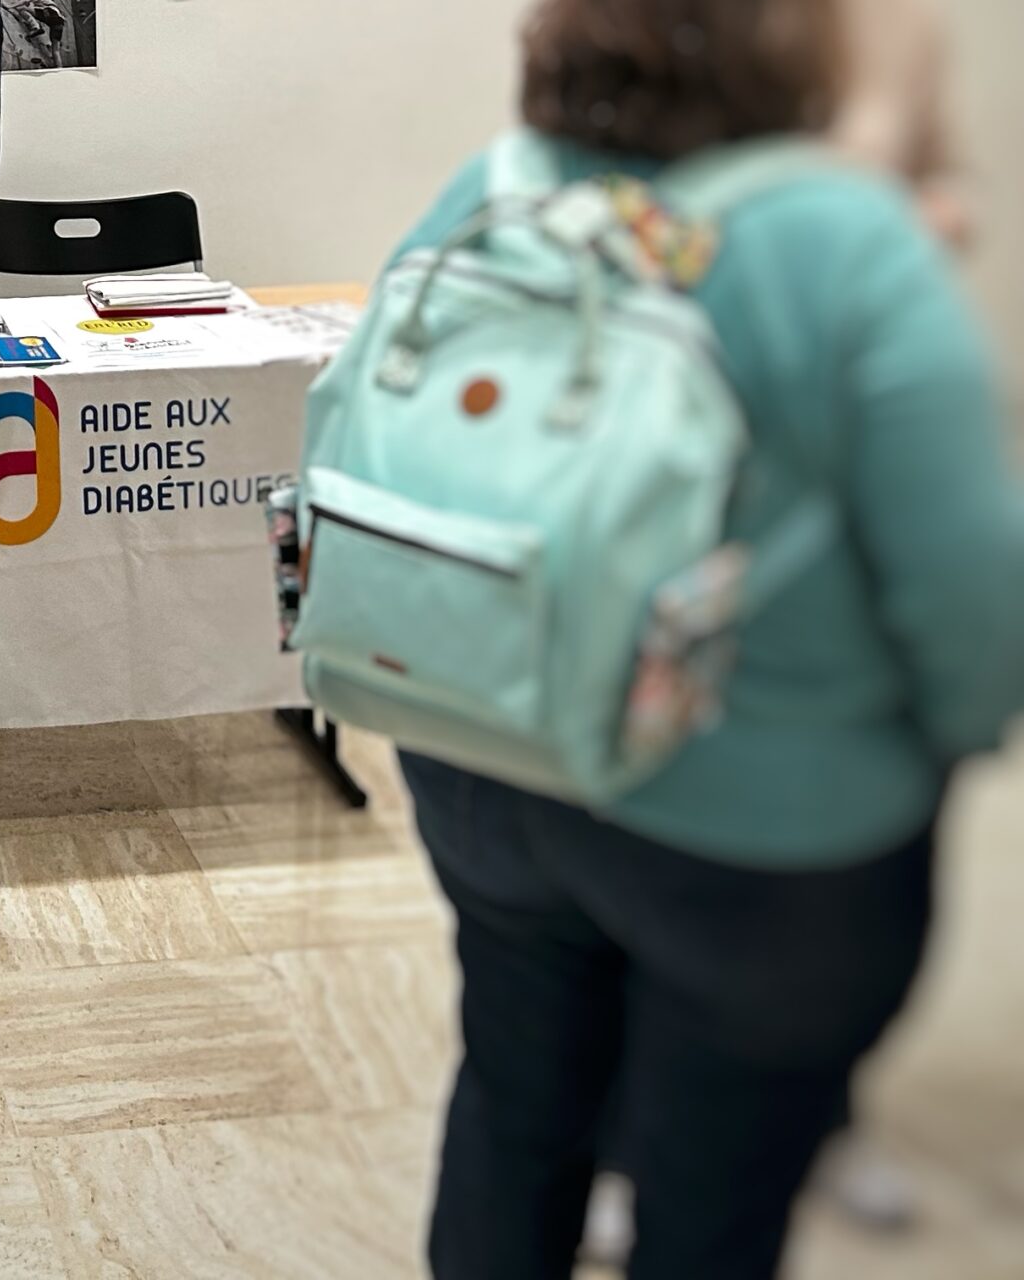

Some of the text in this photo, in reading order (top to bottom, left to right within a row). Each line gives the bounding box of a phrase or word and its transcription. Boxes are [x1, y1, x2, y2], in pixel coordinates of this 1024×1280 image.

[80, 397, 231, 433] AIDE AUX
[82, 439, 205, 474] JEUNES
